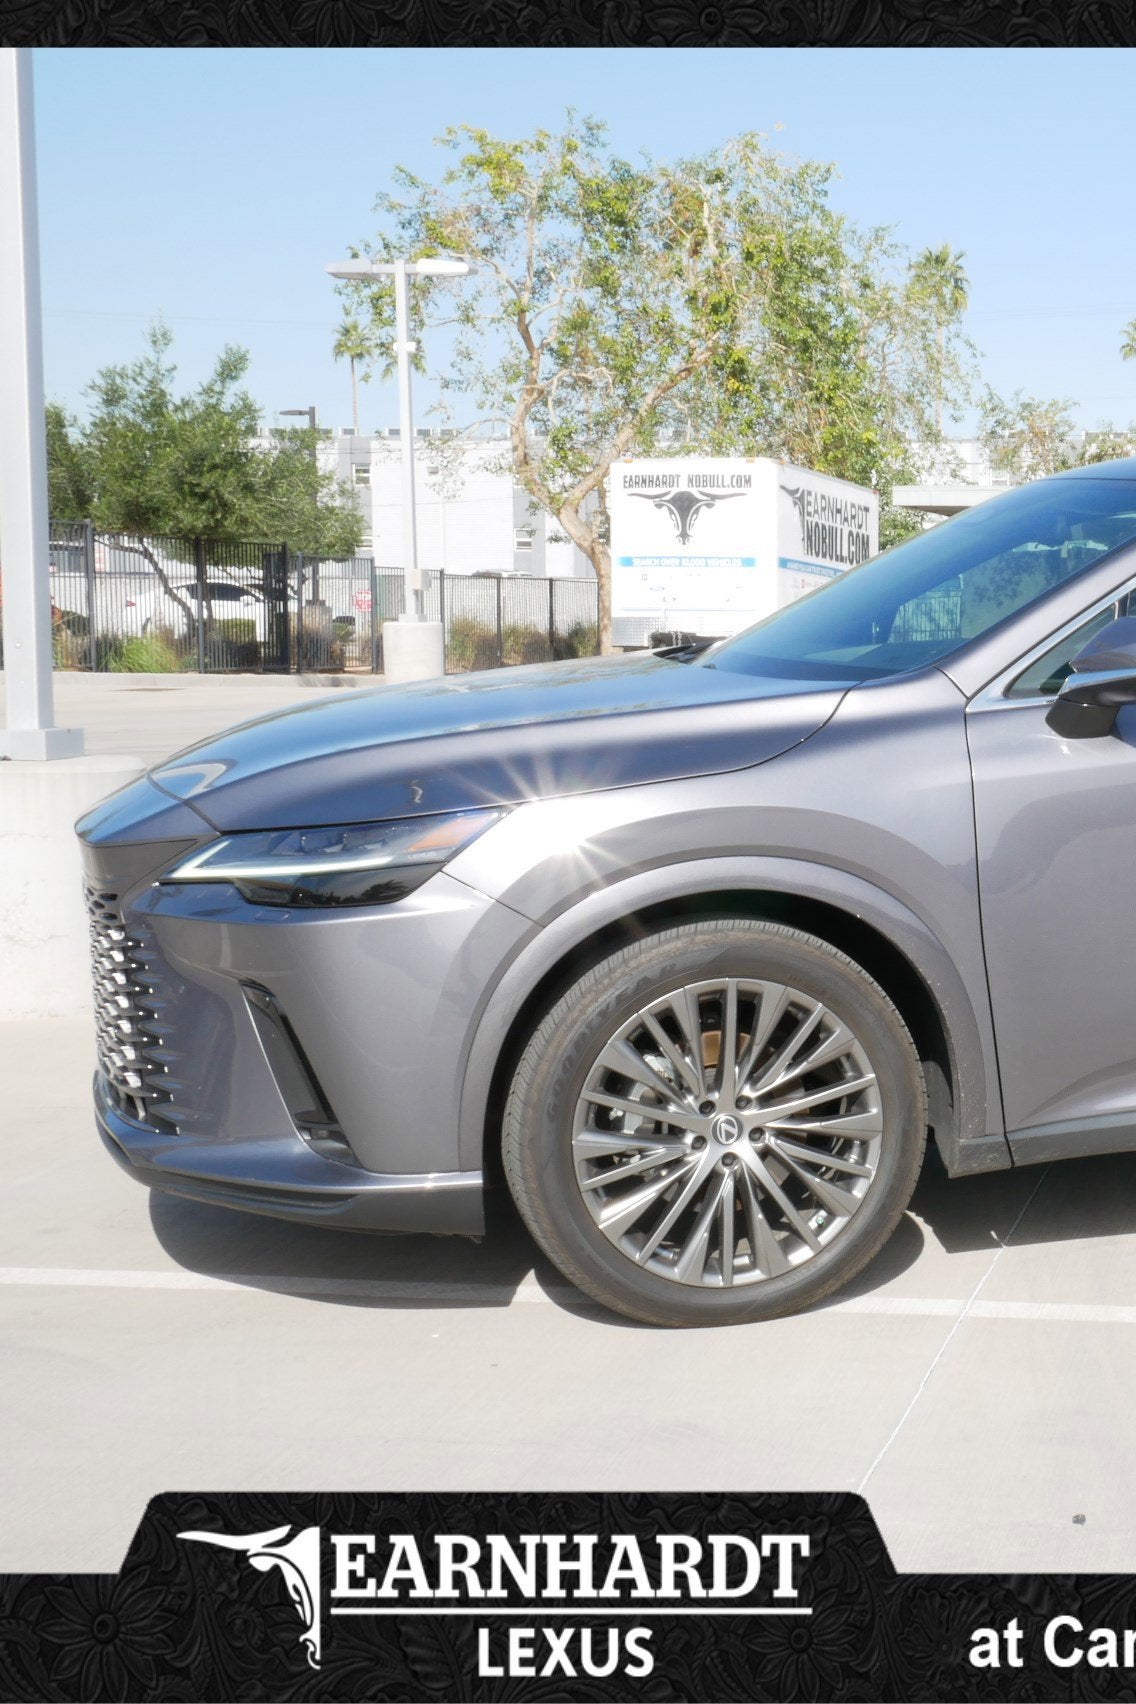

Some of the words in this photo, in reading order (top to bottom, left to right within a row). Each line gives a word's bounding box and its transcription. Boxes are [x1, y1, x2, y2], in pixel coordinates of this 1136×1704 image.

[623, 474, 681, 489] EARNHARDT
[687, 474, 752, 488] NOBULL.COM
[806, 490, 870, 531] EARNHARDT
[806, 519, 870, 566] NOBULL.COM
